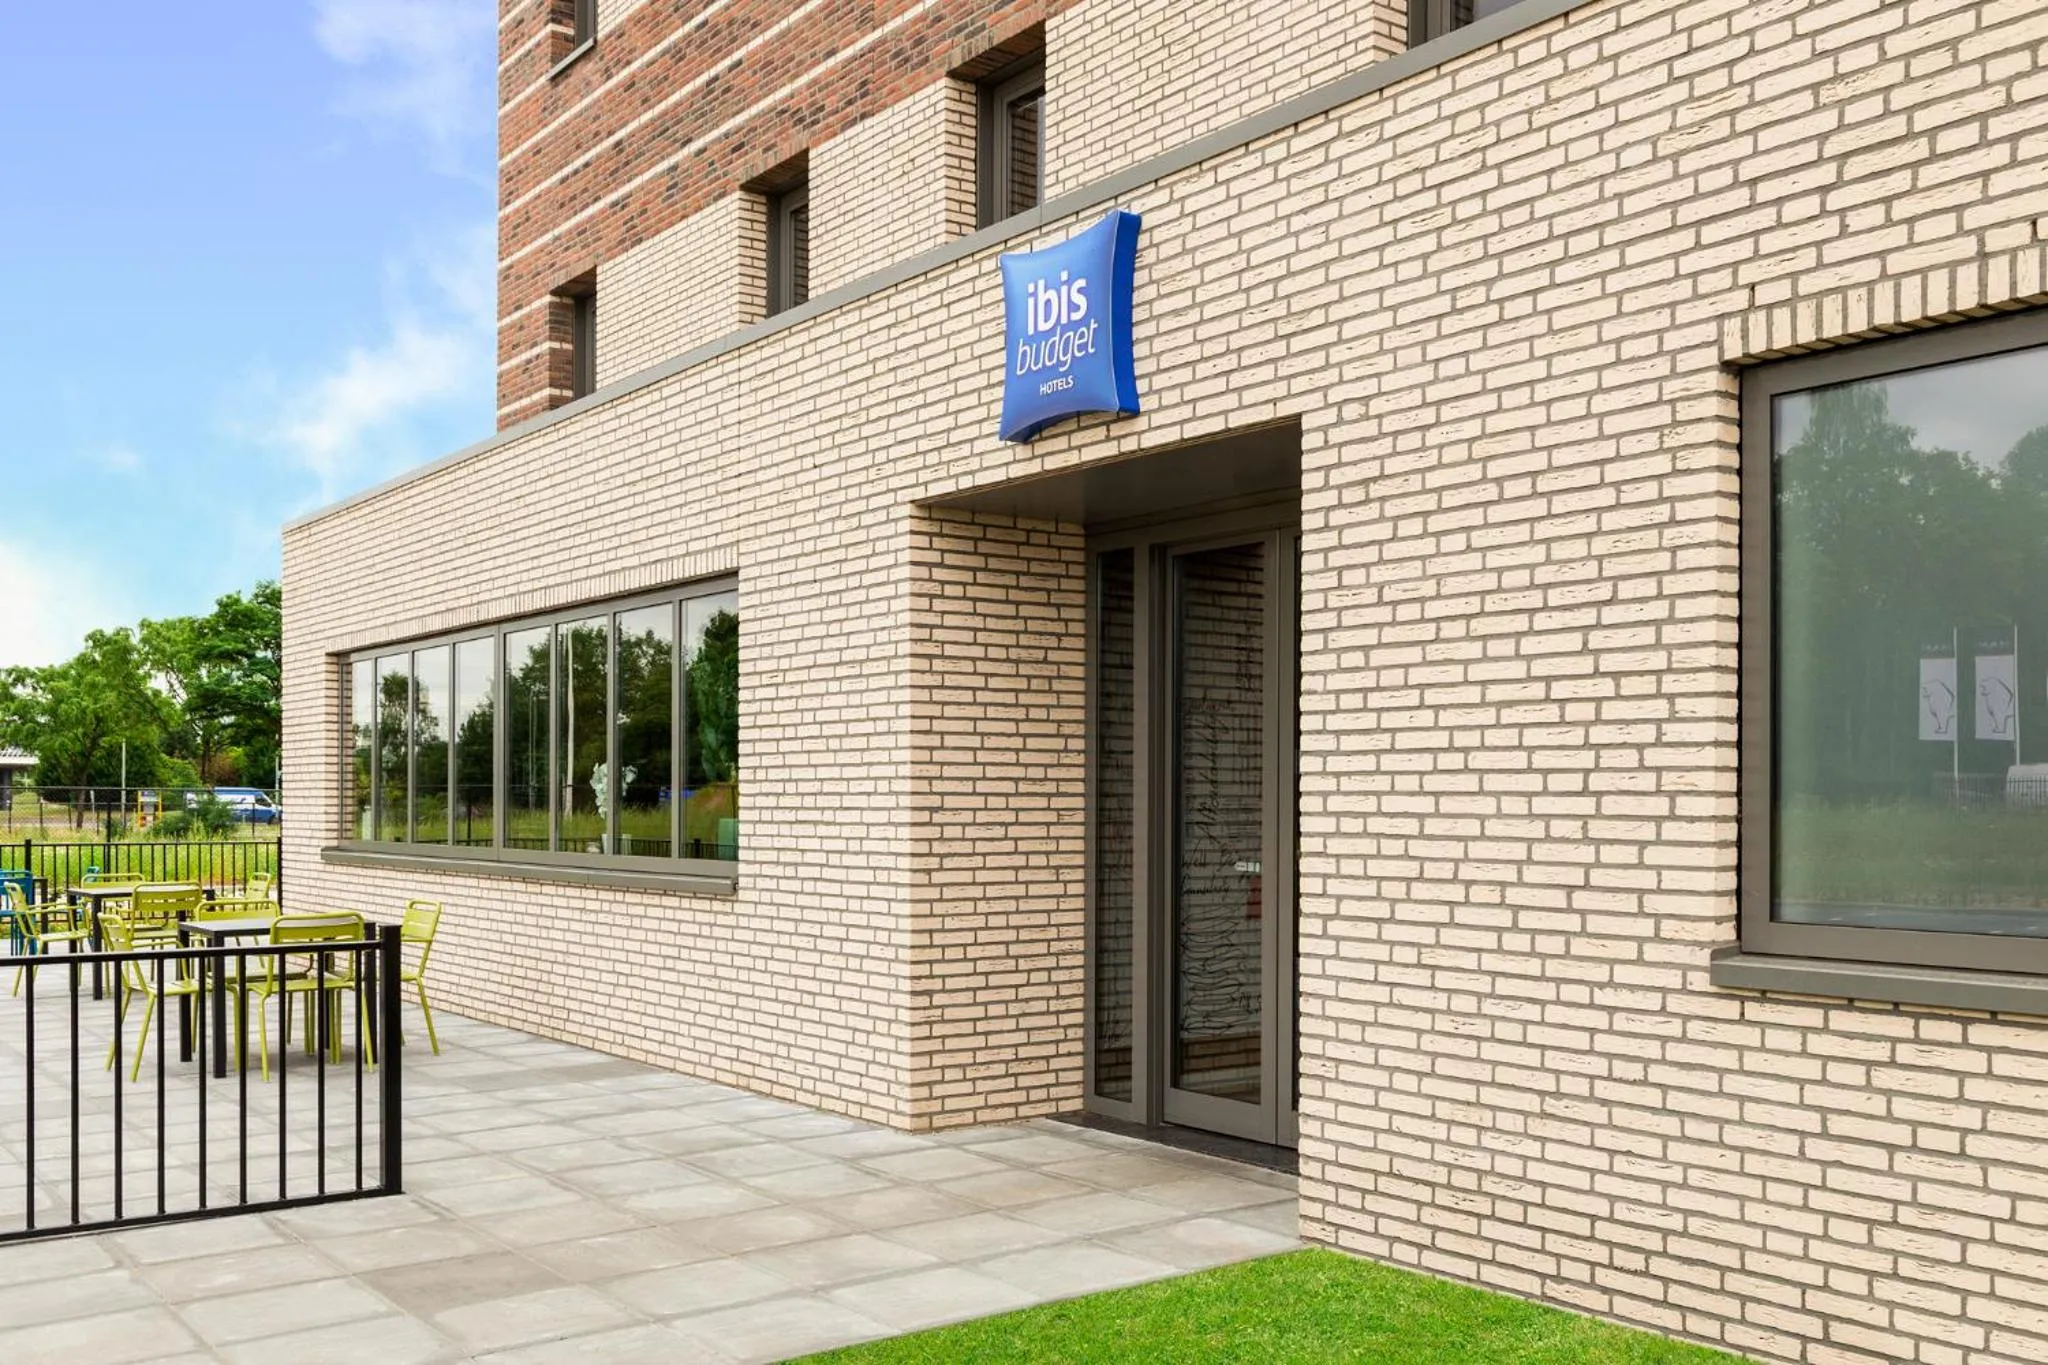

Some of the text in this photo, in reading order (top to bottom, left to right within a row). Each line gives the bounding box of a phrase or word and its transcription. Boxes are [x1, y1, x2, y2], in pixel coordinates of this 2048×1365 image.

[1027, 270, 1087, 336] ibis
[1016, 318, 1098, 376] budget
[1039, 375, 1074, 396] HOTELS
